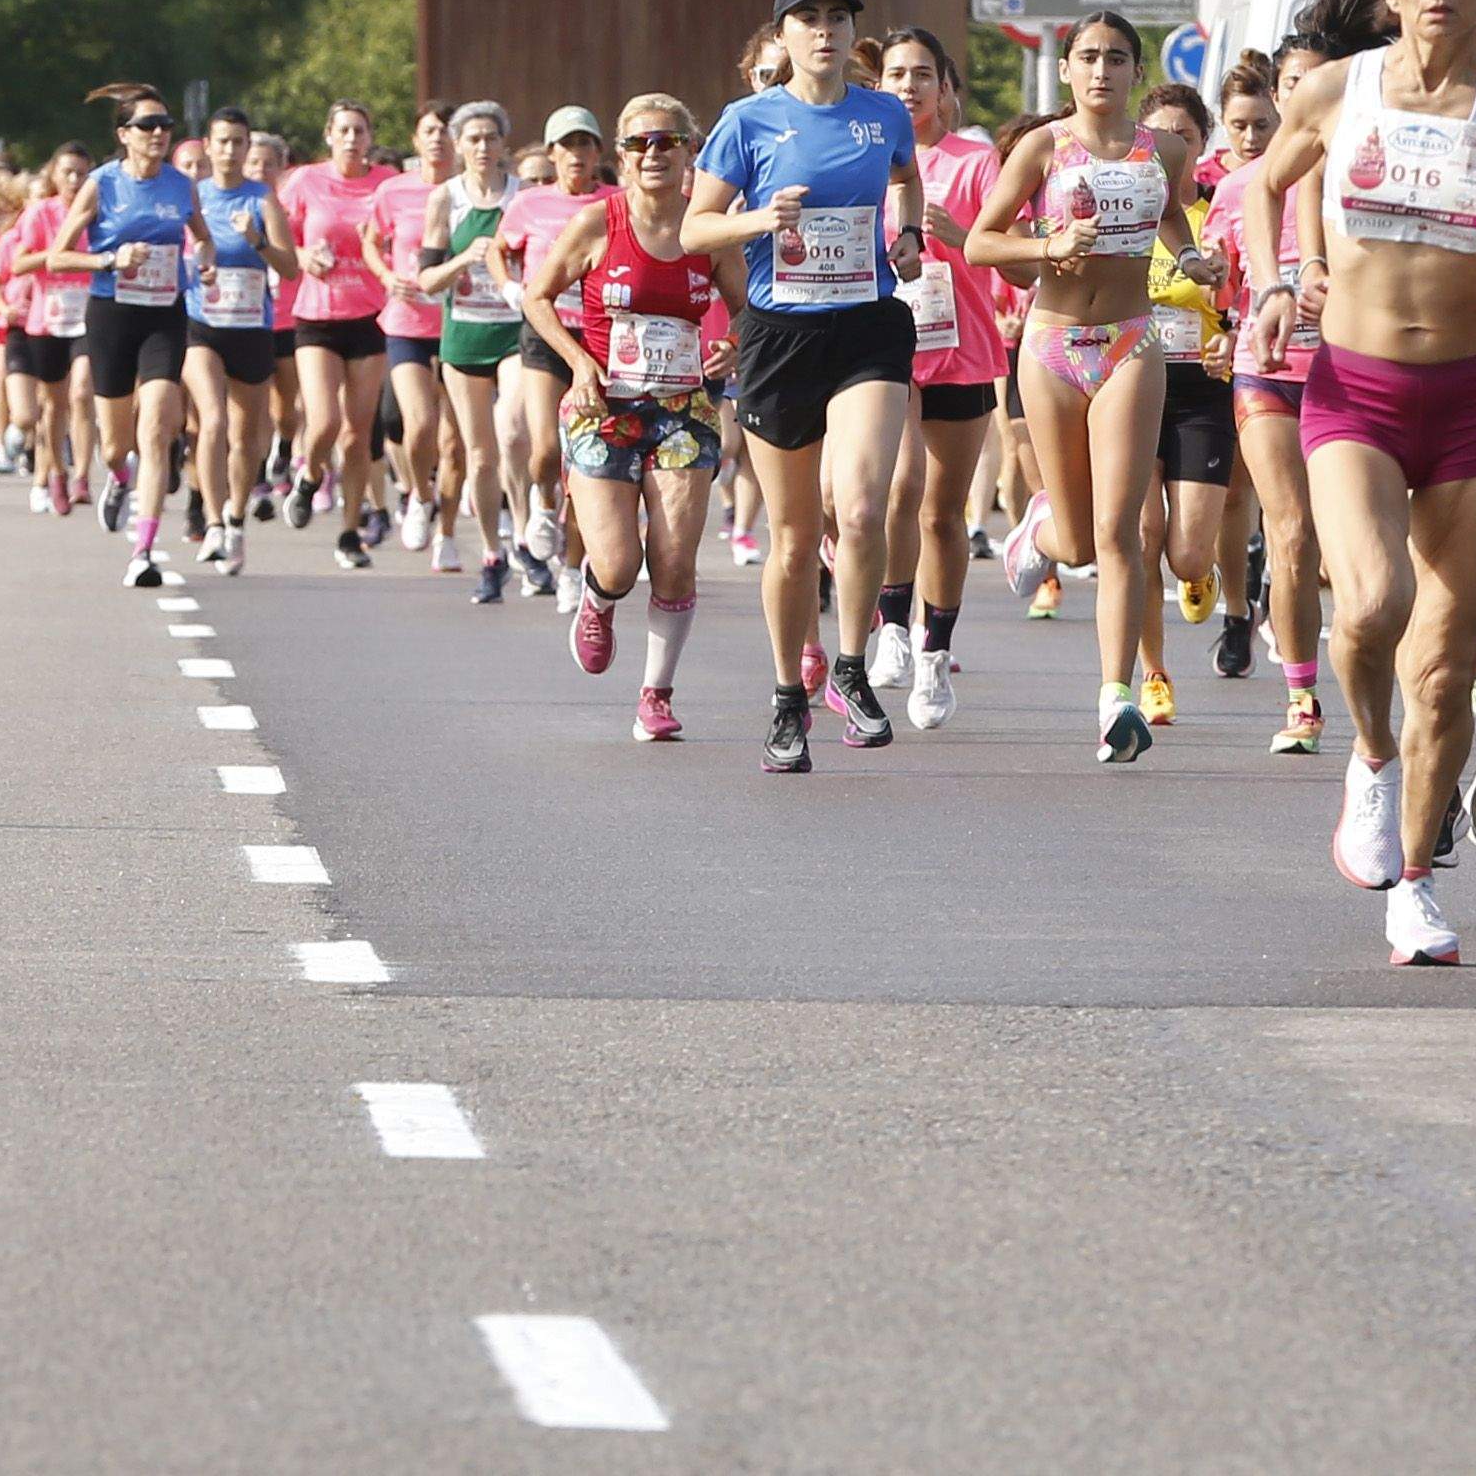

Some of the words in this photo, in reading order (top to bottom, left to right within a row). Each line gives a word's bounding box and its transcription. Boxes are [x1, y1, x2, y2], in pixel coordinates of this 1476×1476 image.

[1390, 164, 1442, 188] 016
[1408, 191, 1417, 203] 5
[1099, 197, 1134, 212] 016
[1113, 215, 1119, 223] 4
[809, 245, 845, 259] 016
[643, 346, 675, 362] 016
